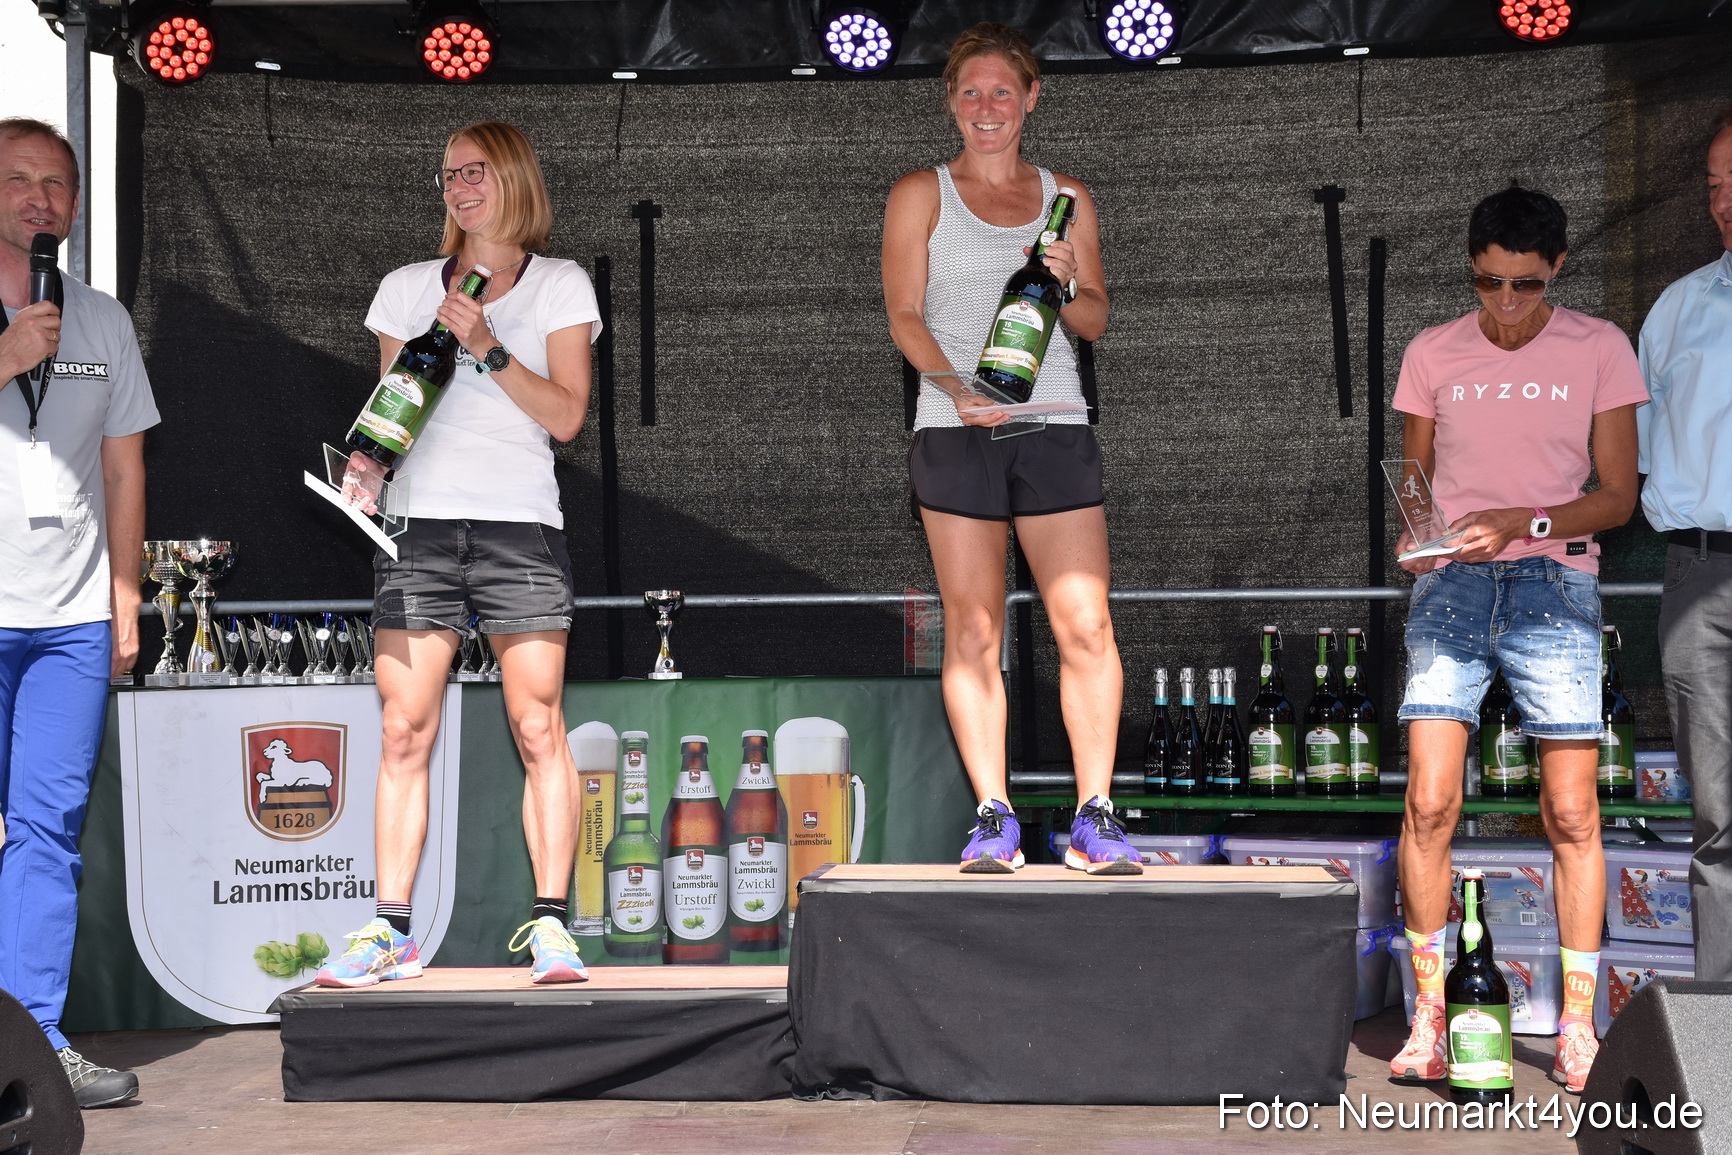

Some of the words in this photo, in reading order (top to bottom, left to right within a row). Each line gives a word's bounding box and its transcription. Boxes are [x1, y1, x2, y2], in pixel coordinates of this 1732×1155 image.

[53, 362, 108, 377] BOCK
[1452, 383, 1568, 401] RYZON
[1411, 508, 1423, 516] 19.
[741, 776, 770, 785] Zwickl
[680, 784, 711, 794] Urstoff
[273, 812, 315, 829] 1628
[593, 800, 603, 863] Lammsbräu
[789, 838, 832, 846] Lammsbräu
[235, 854, 354, 875] Neumarkter
[735, 866, 778, 874] Lammsbräu
[213, 874, 375, 905] Lammsbräu
[672, 880, 719, 889] Lammsbräu
[737, 878, 776, 890] Zwickl
[674, 893, 718, 906] Urstoff
[1459, 1033, 1470, 1041] 19.
